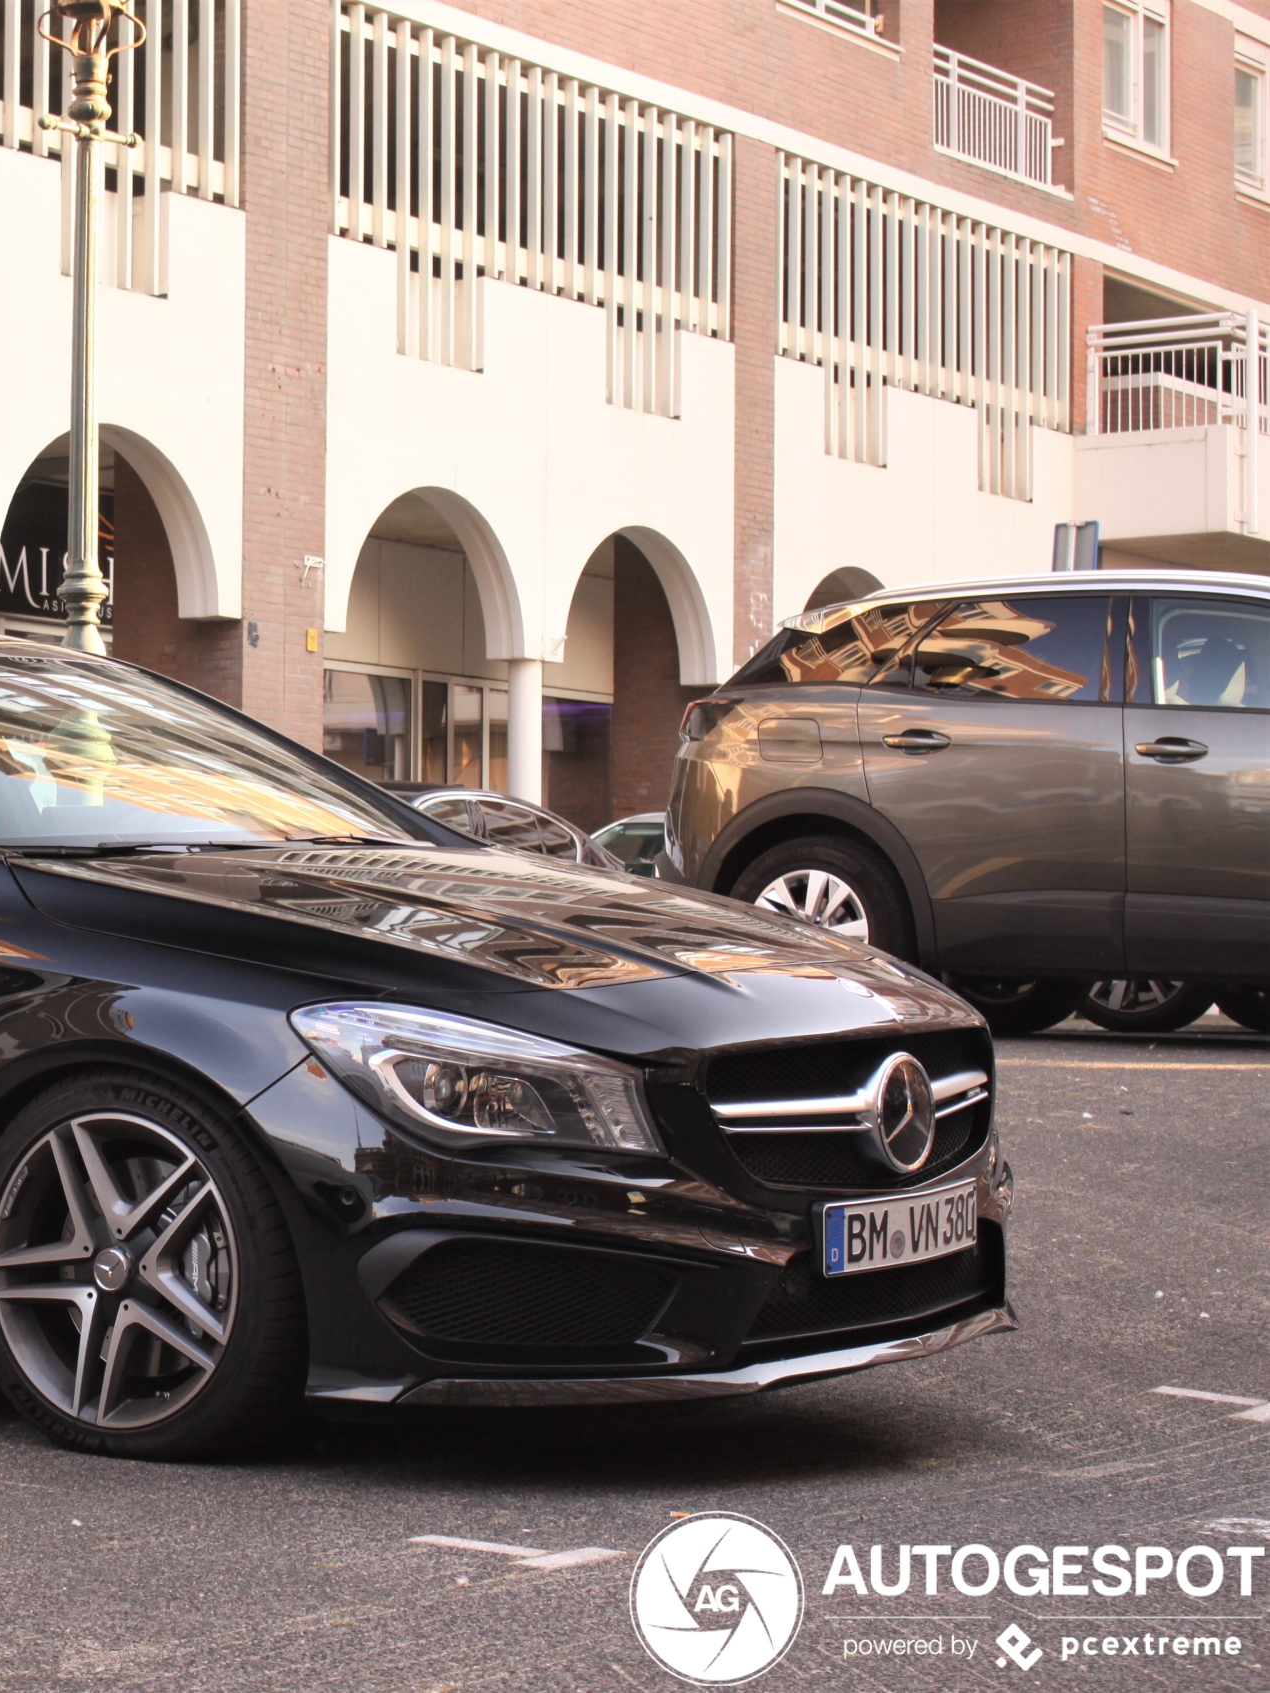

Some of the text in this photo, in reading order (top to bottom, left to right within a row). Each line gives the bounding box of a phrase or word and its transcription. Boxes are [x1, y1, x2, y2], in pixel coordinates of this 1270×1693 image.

[119, 1087, 214, 1149] MICHELIN
[831, 1247, 839, 1262] D
[847, 1209, 889, 1264] BM
[909, 1199, 940, 1254] VN
